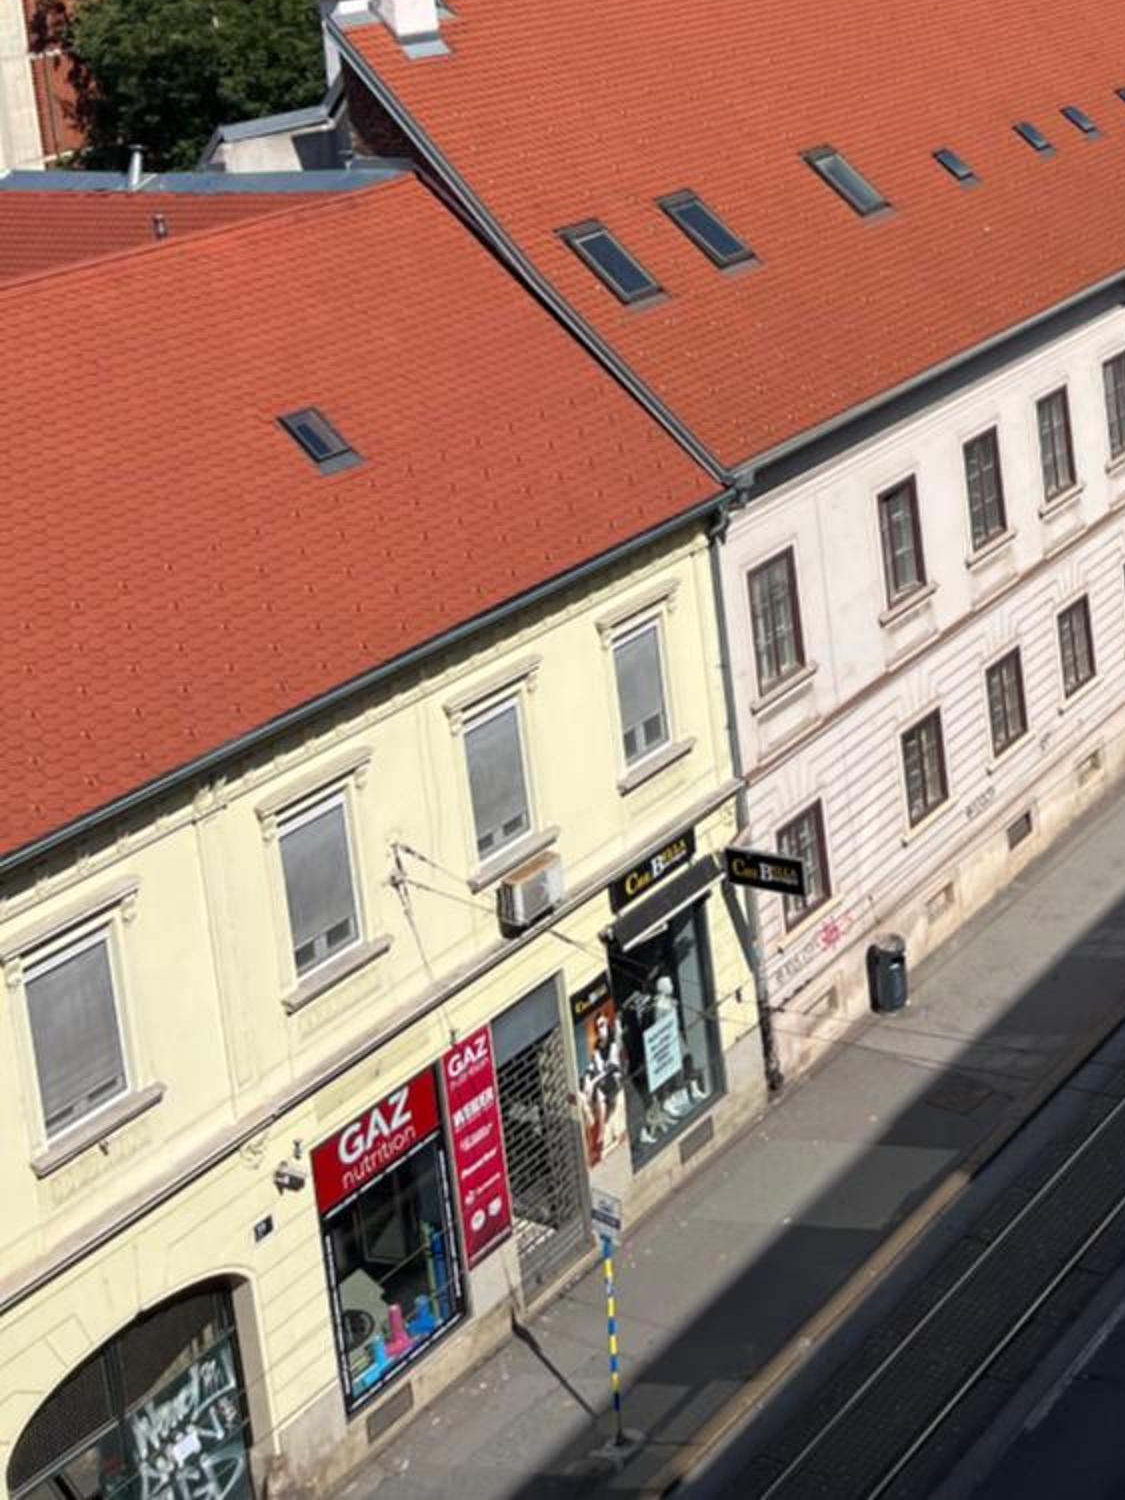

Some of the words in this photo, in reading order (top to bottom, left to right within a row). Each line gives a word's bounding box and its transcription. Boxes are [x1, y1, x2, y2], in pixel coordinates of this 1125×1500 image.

[447, 1034, 489, 1078] GAZ
[337, 1086, 412, 1164] GAZ
[341, 1125, 416, 1189] nutrition
